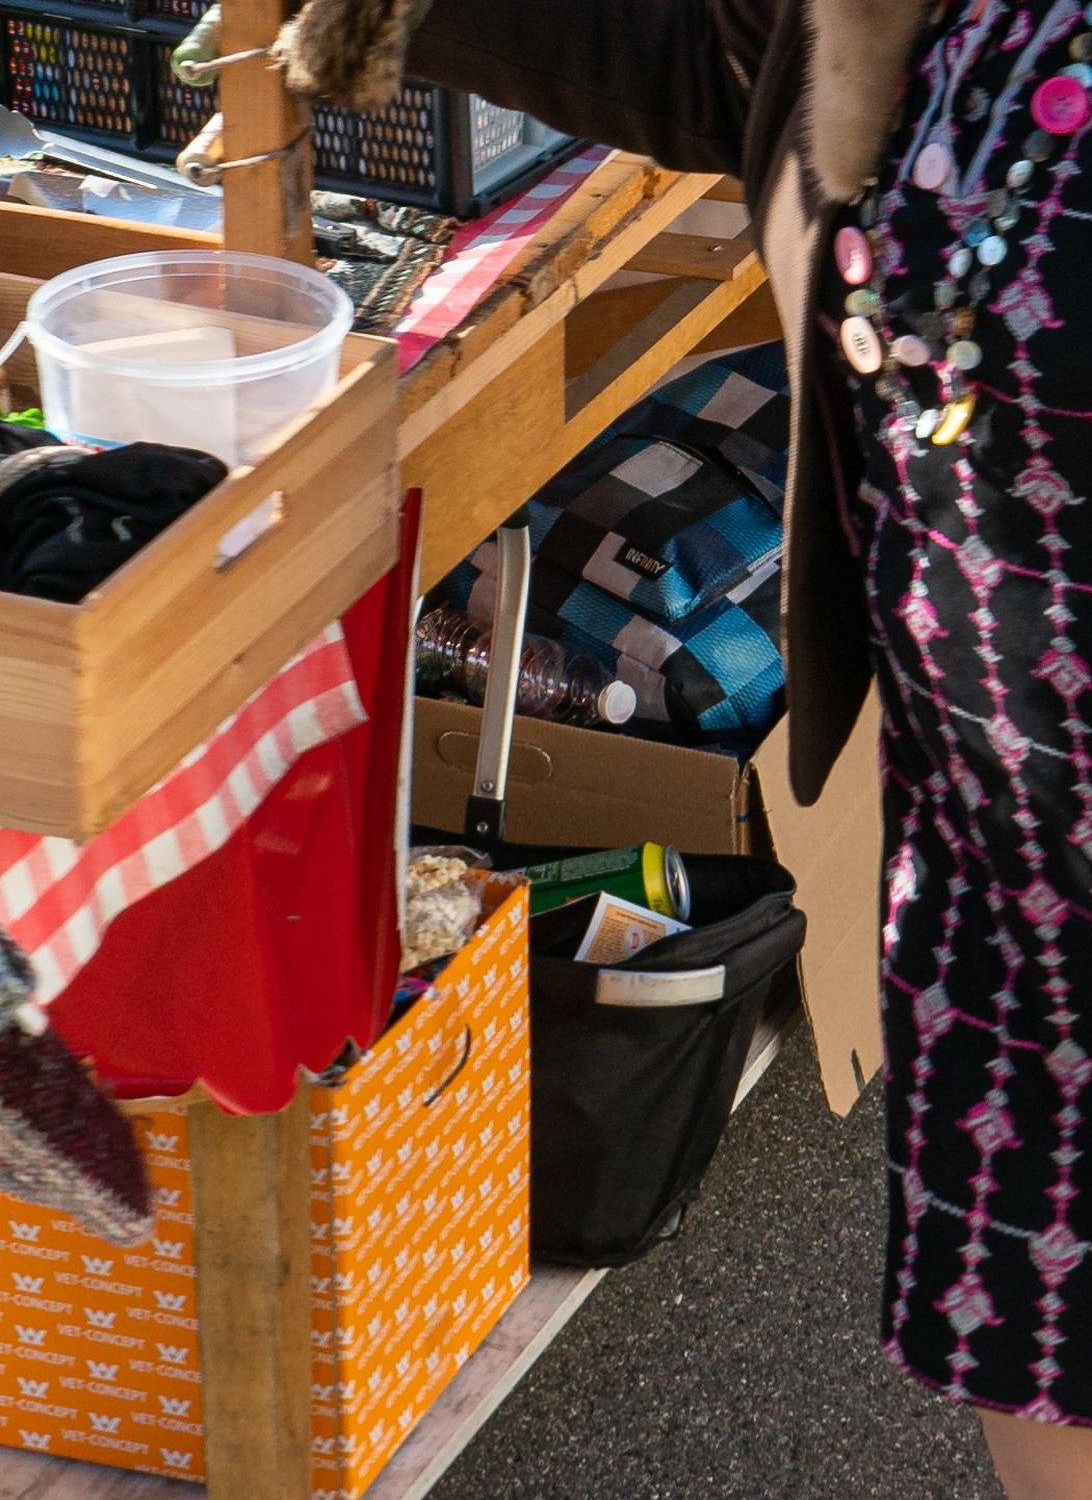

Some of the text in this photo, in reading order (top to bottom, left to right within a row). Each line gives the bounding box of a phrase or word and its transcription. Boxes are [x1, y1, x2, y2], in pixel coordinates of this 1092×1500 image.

[625, 548, 666, 574] INFINITY
[53, 1271, 143, 1296] VET-CONCEPT
[56, 1323, 146, 1349] VET-CONCEPT
[59, 1375, 148, 1402] VET-CONCEPT
[61, 1428, 149, 1455] VET-CONCEPT
